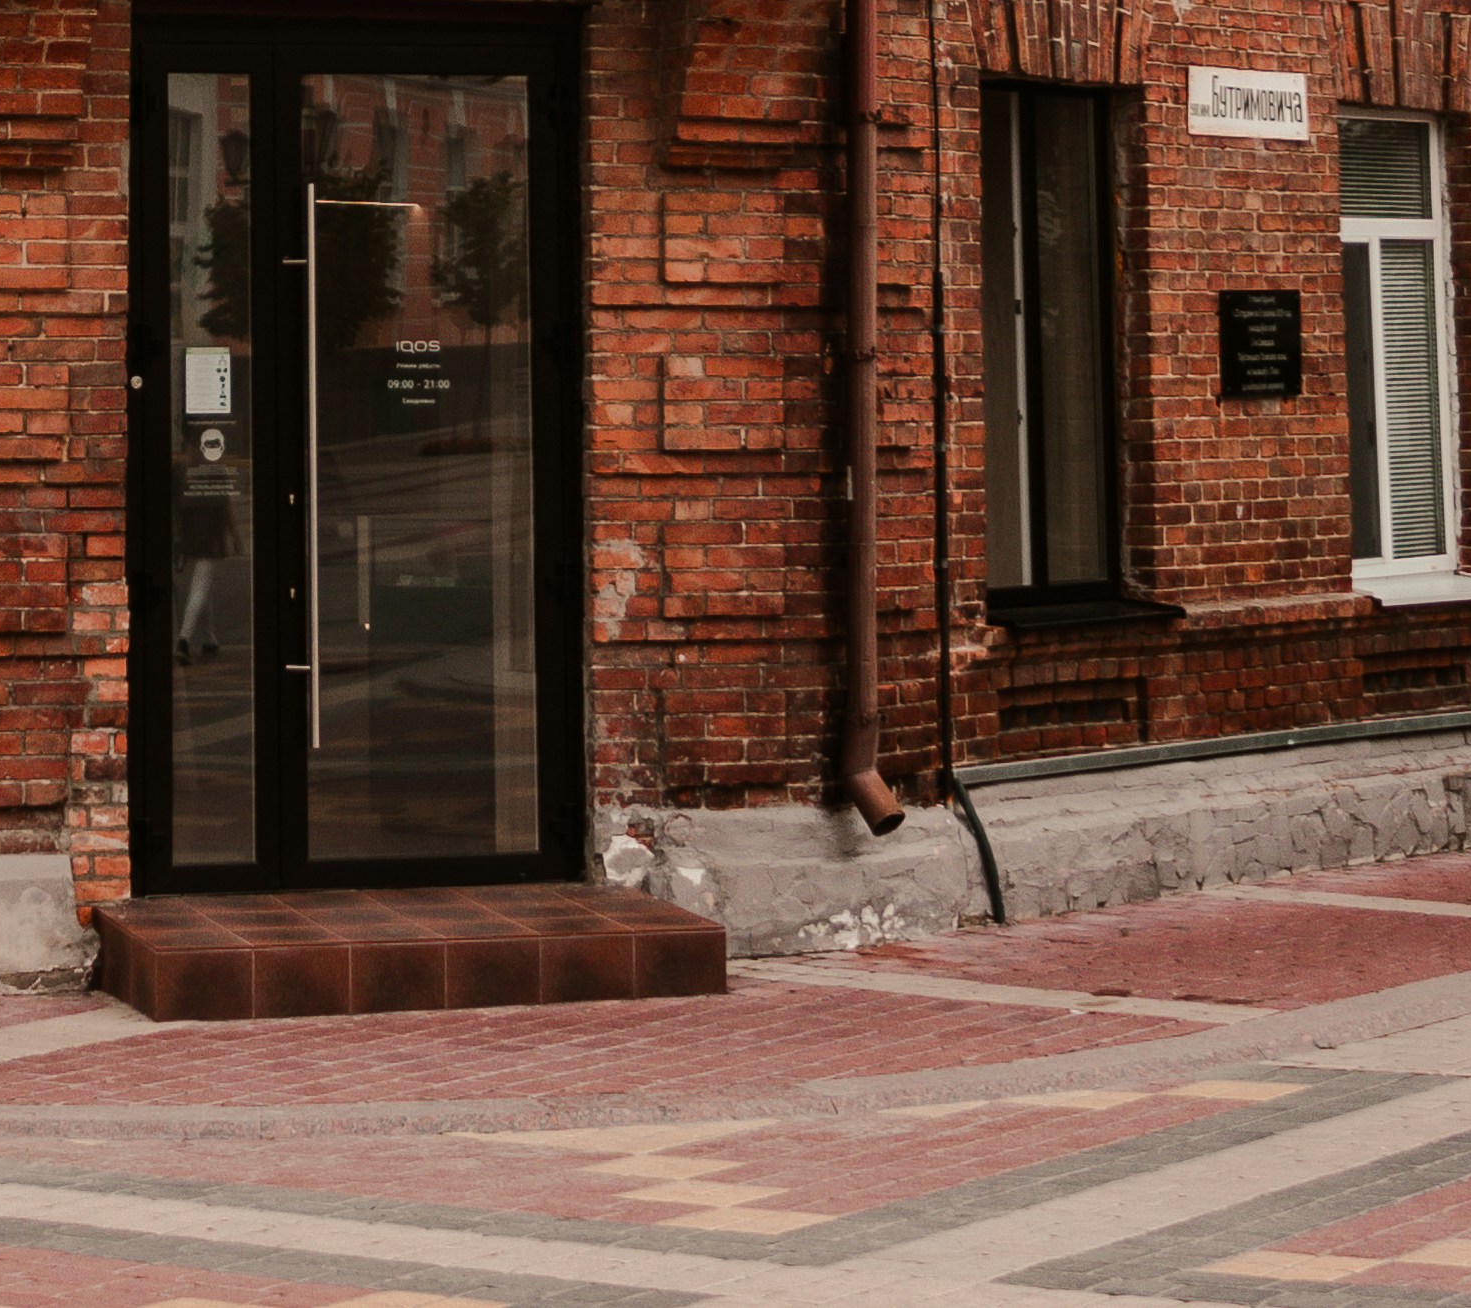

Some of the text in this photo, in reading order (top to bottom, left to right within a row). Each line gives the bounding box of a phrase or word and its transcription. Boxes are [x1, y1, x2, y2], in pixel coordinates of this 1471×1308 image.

[1212, 74, 1303, 123] Бутримовича
[396, 340, 440, 354] IQOS
[387, 379, 414, 389] 09:00
[423, 379, 451, 389] 21:00
